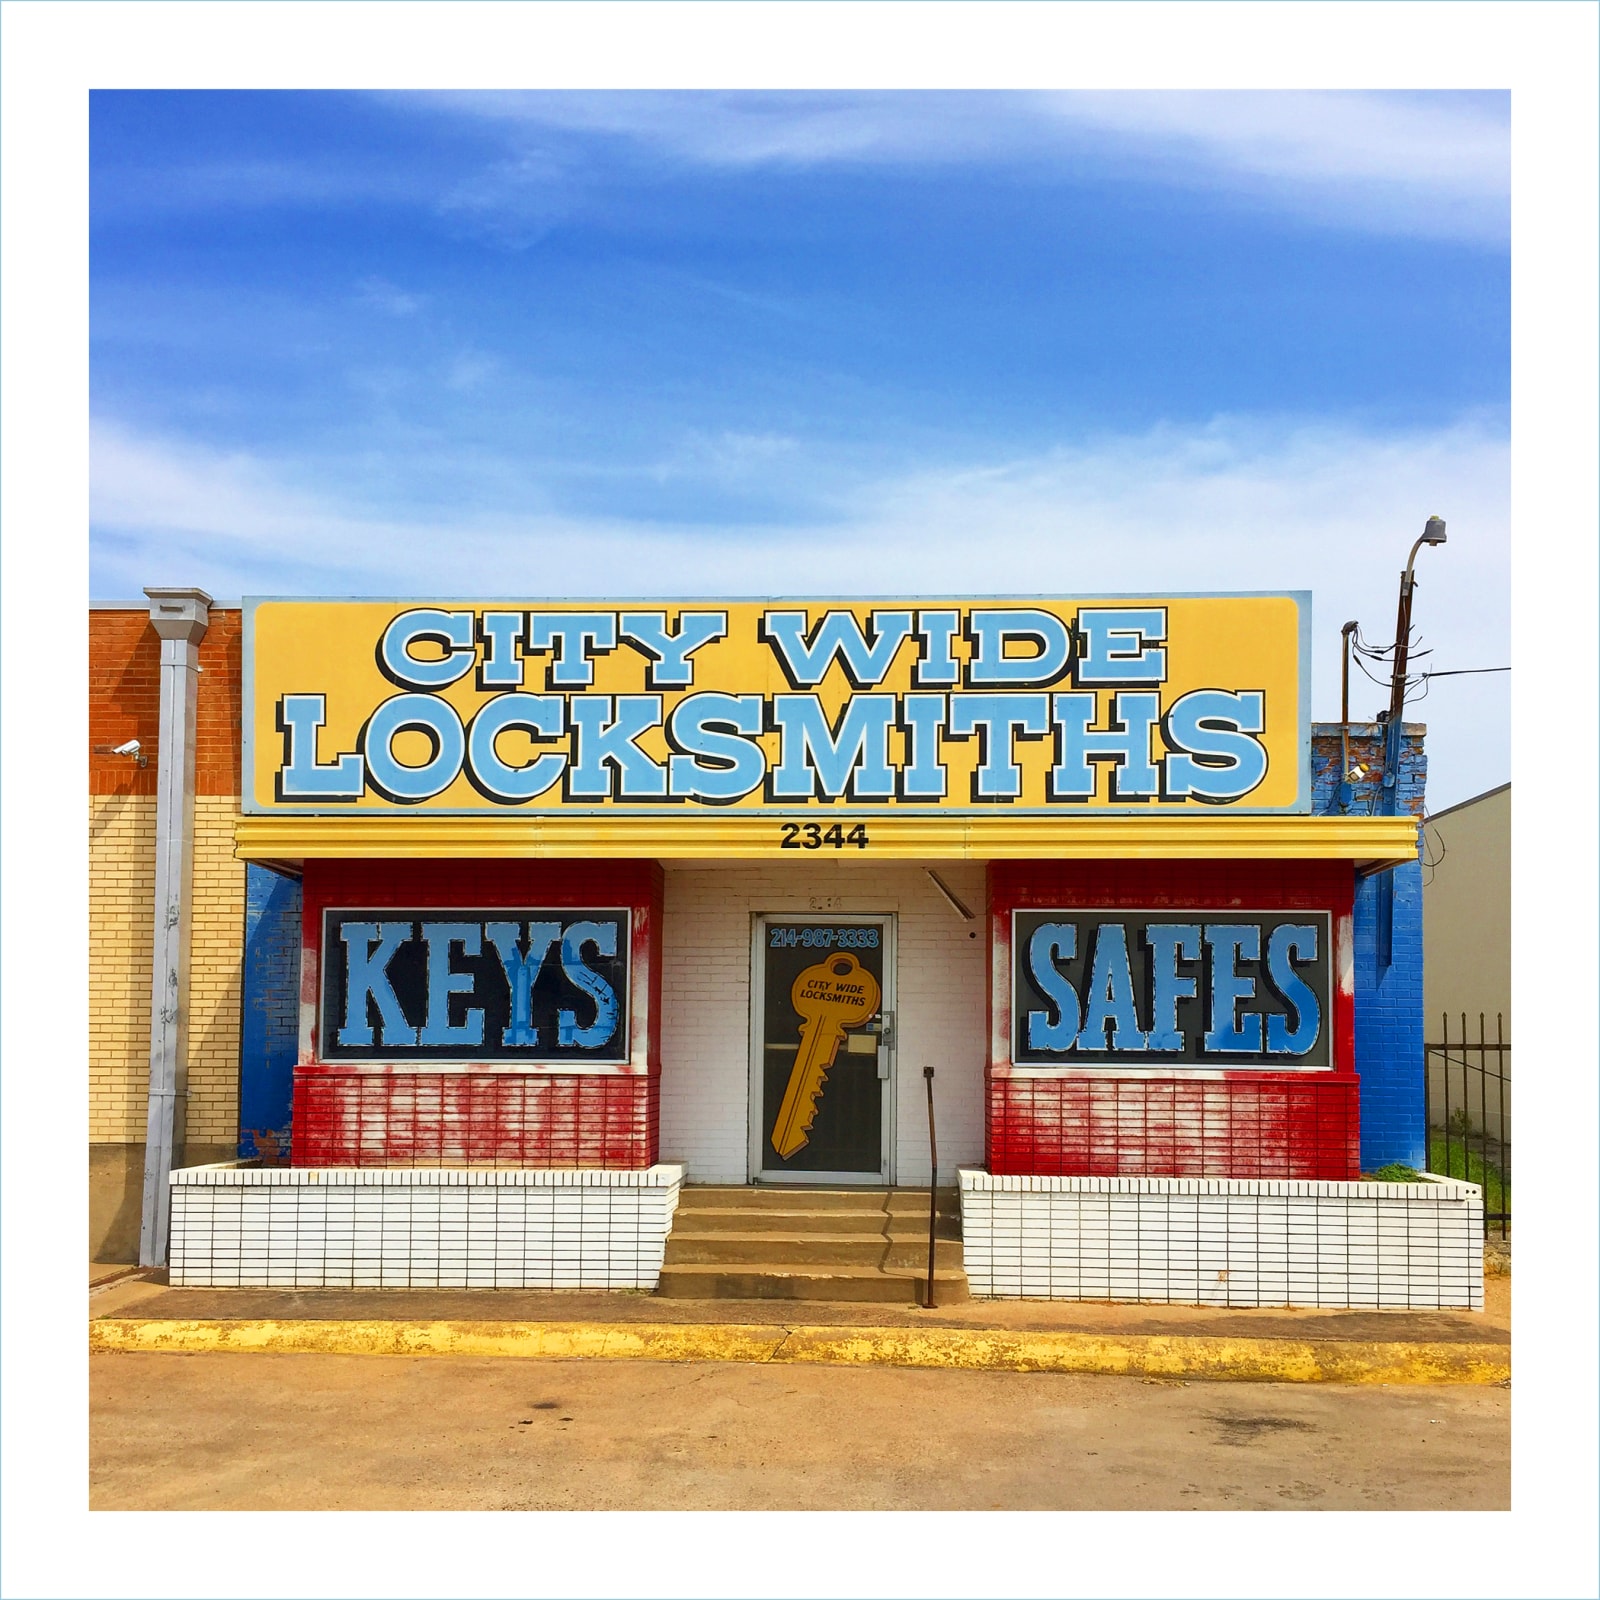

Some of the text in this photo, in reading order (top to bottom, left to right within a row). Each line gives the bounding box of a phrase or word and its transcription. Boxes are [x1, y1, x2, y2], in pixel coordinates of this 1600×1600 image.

[375, 607, 1169, 692] CITY WIDE
[275, 689, 1269, 805] LOCKSMITHS
[780, 823, 869, 849] 2344
[770, 928, 879, 948] 214-987-3333
[337, 921, 620, 1049] KEYS
[800, 989, 866, 1006] LOCKSMITHS
[807, 979, 865, 994] CITY WIDE
[1024, 922, 1321, 1057] SAFES
